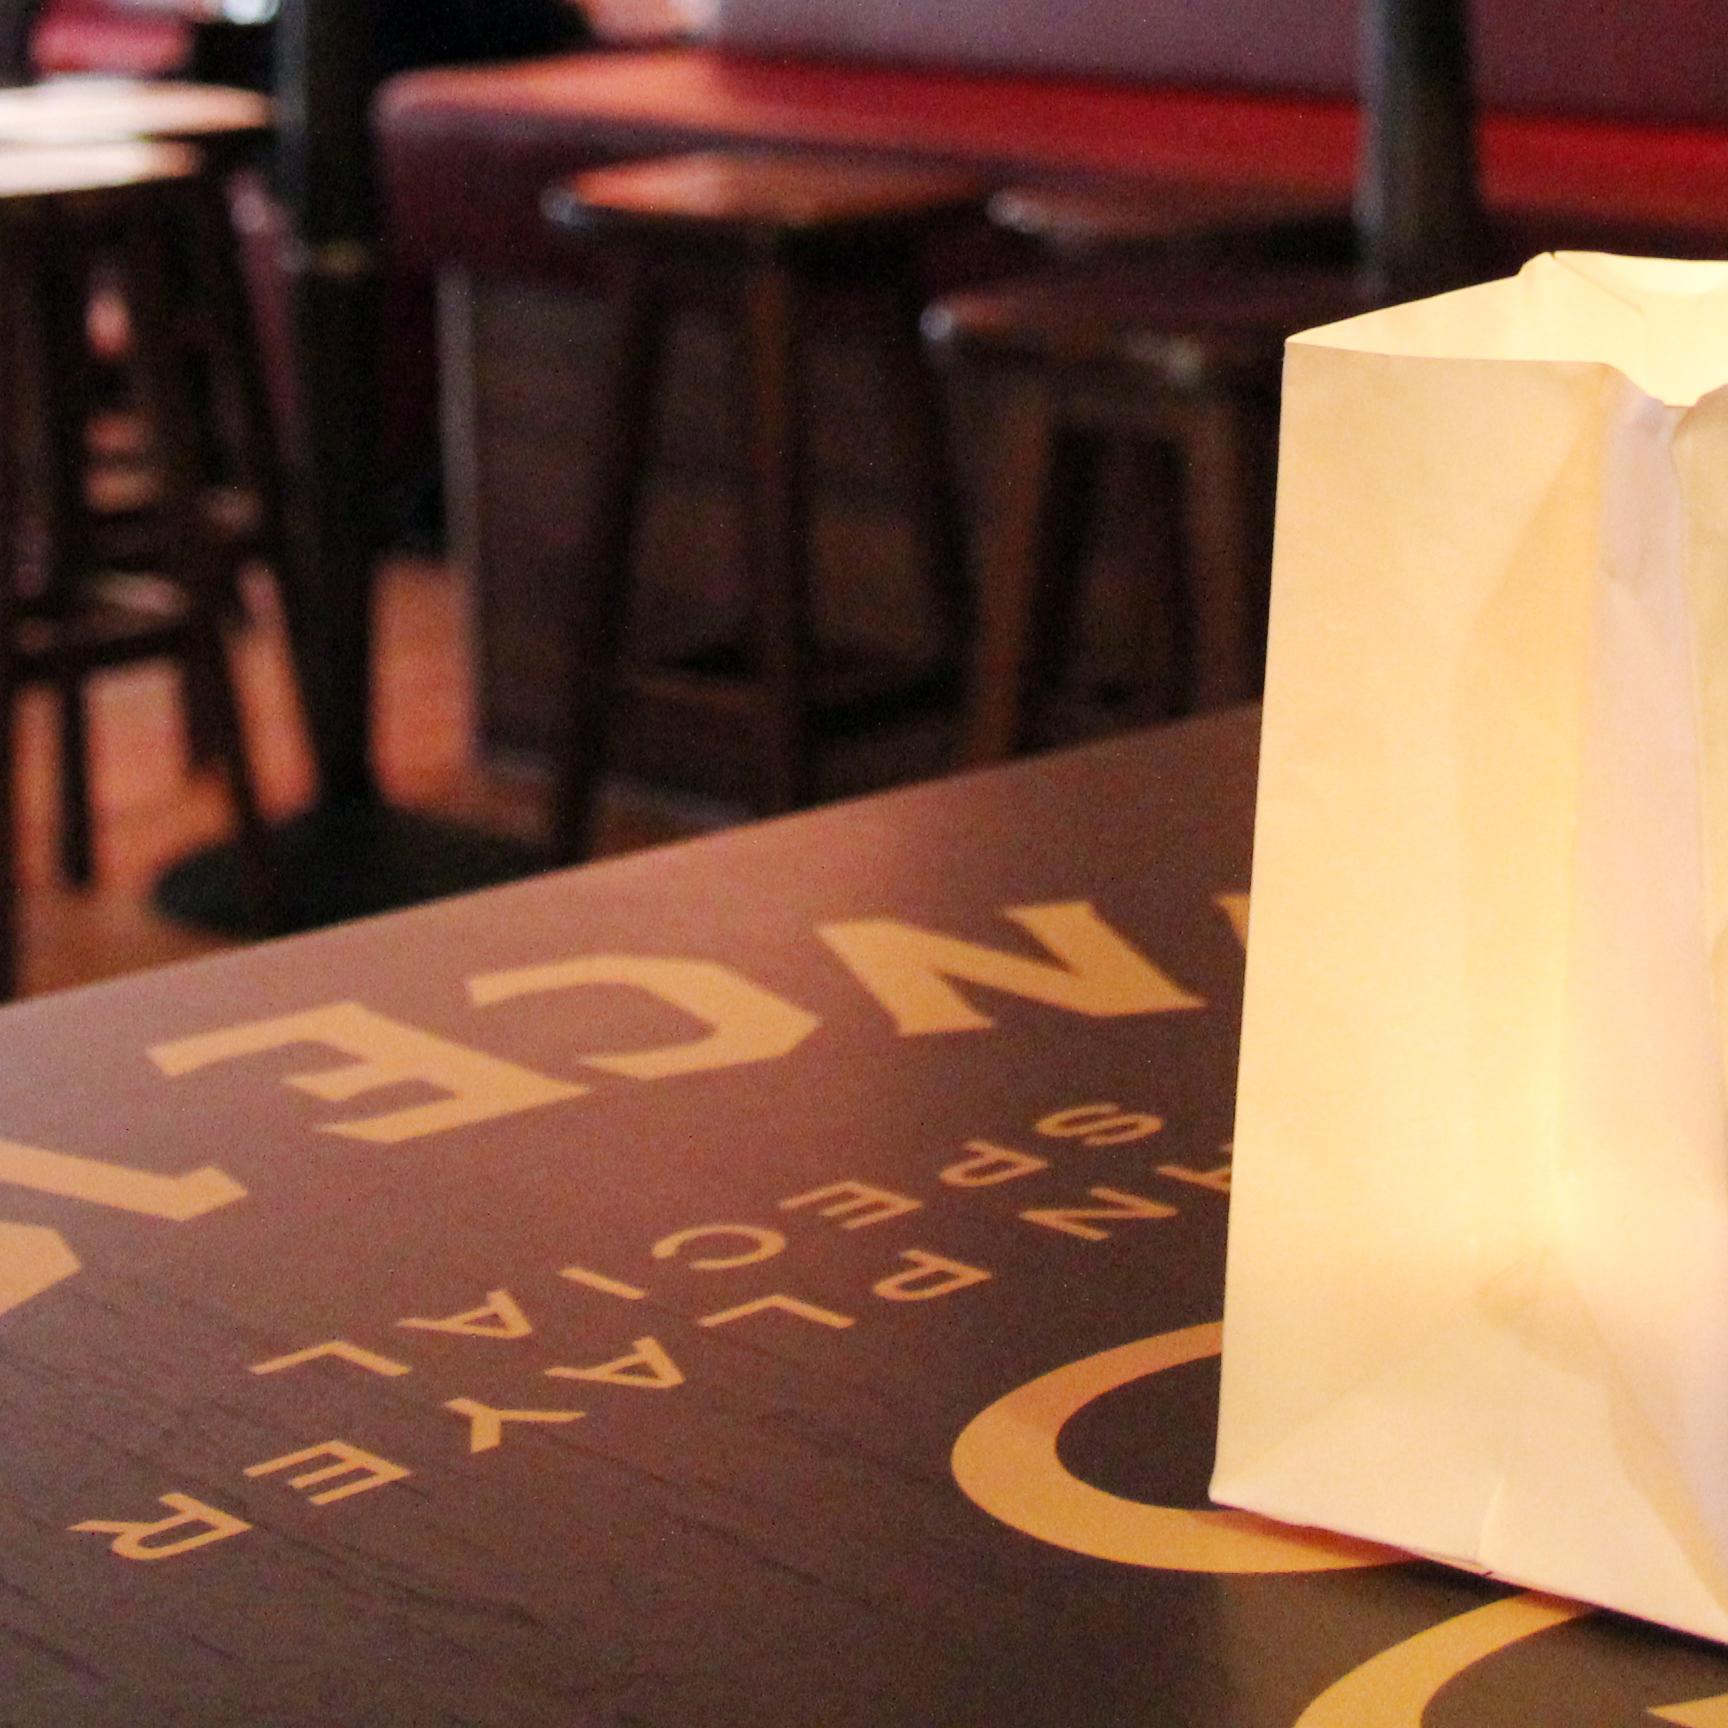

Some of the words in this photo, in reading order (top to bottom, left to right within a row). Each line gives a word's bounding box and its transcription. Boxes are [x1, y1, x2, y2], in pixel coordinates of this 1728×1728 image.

[145, 892, 1249, 1144] NCE
[250, 1102, 1163, 1378] SPECIAL
[69, 1248, 993, 1561] PLAYER
